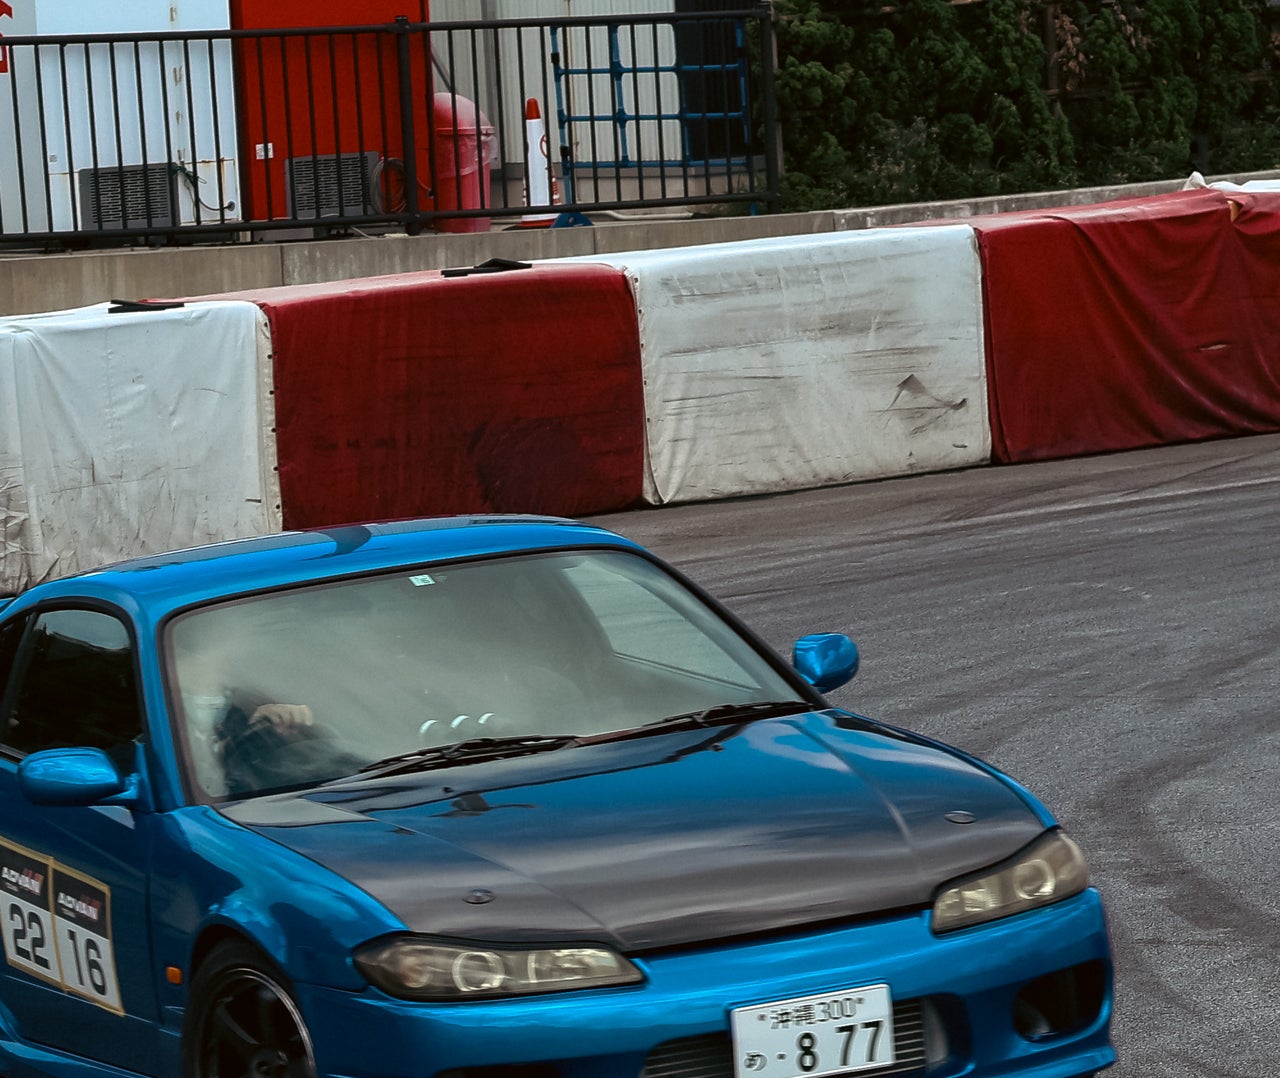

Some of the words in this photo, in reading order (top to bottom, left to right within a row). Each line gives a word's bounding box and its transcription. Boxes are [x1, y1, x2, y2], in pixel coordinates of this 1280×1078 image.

[1, 866, 43, 895] ADVAN
[57, 891, 99, 921] ADVAN
[9, 903, 50, 970] 22
[66, 928, 107, 996] 16
